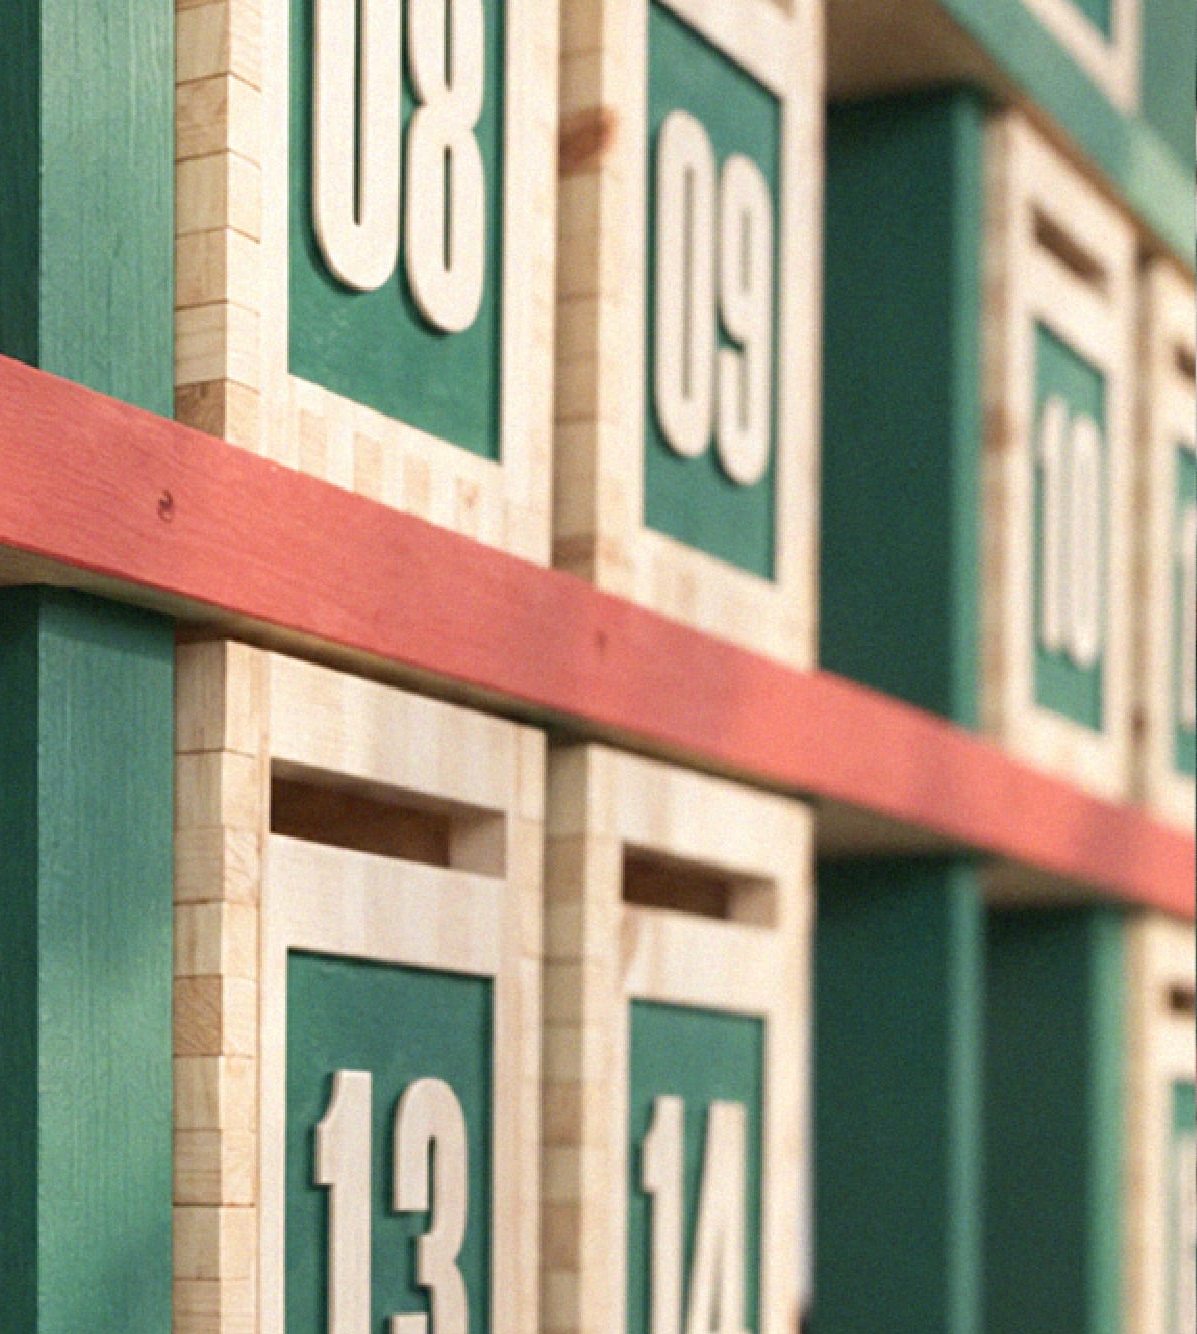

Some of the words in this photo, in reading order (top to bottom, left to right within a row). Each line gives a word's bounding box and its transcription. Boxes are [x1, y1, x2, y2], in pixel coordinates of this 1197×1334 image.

[312, 0, 486, 334] 08
[653, 109, 773, 486] 09
[1038, 393, 1103, 669] 10
